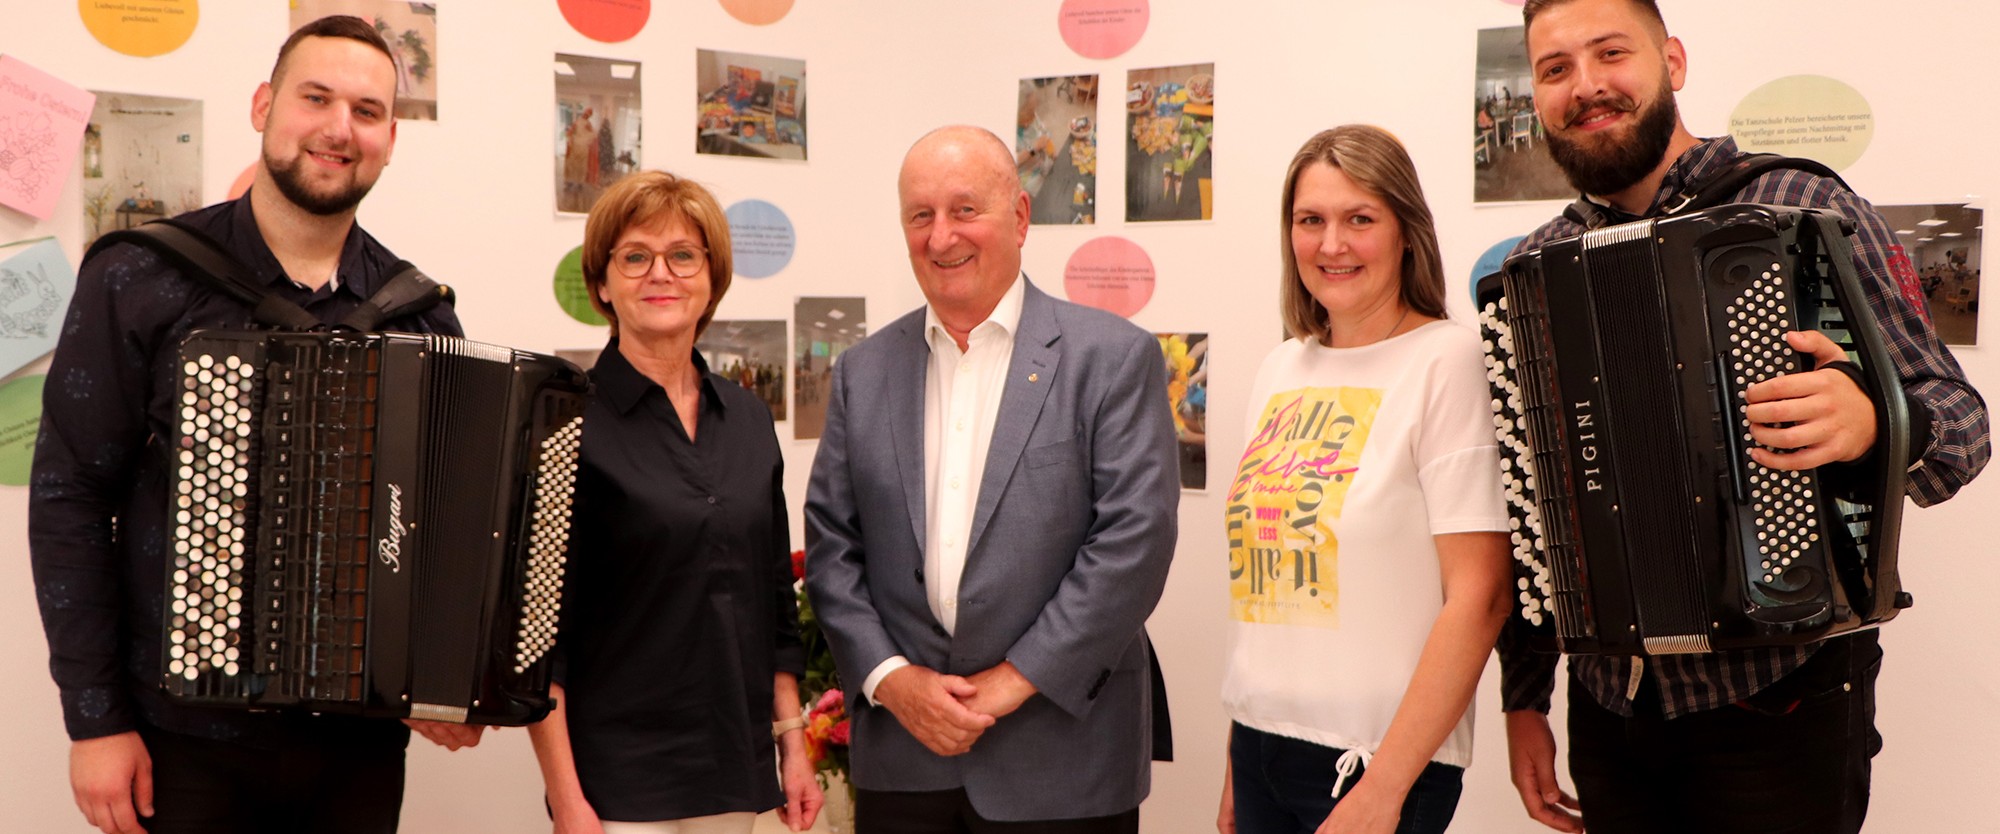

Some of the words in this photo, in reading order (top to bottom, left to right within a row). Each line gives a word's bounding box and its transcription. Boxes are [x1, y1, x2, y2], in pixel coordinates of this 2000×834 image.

[1731, 119, 1744, 127] Die
[1285, 400, 1335, 442] all
[1575, 400, 1602, 492] PIGINI
[1252, 480, 1298, 495] more
[1255, 506, 1282, 521] WORRY
[378, 483, 407, 573] Bugari
[1258, 526, 1278, 541] LESS
